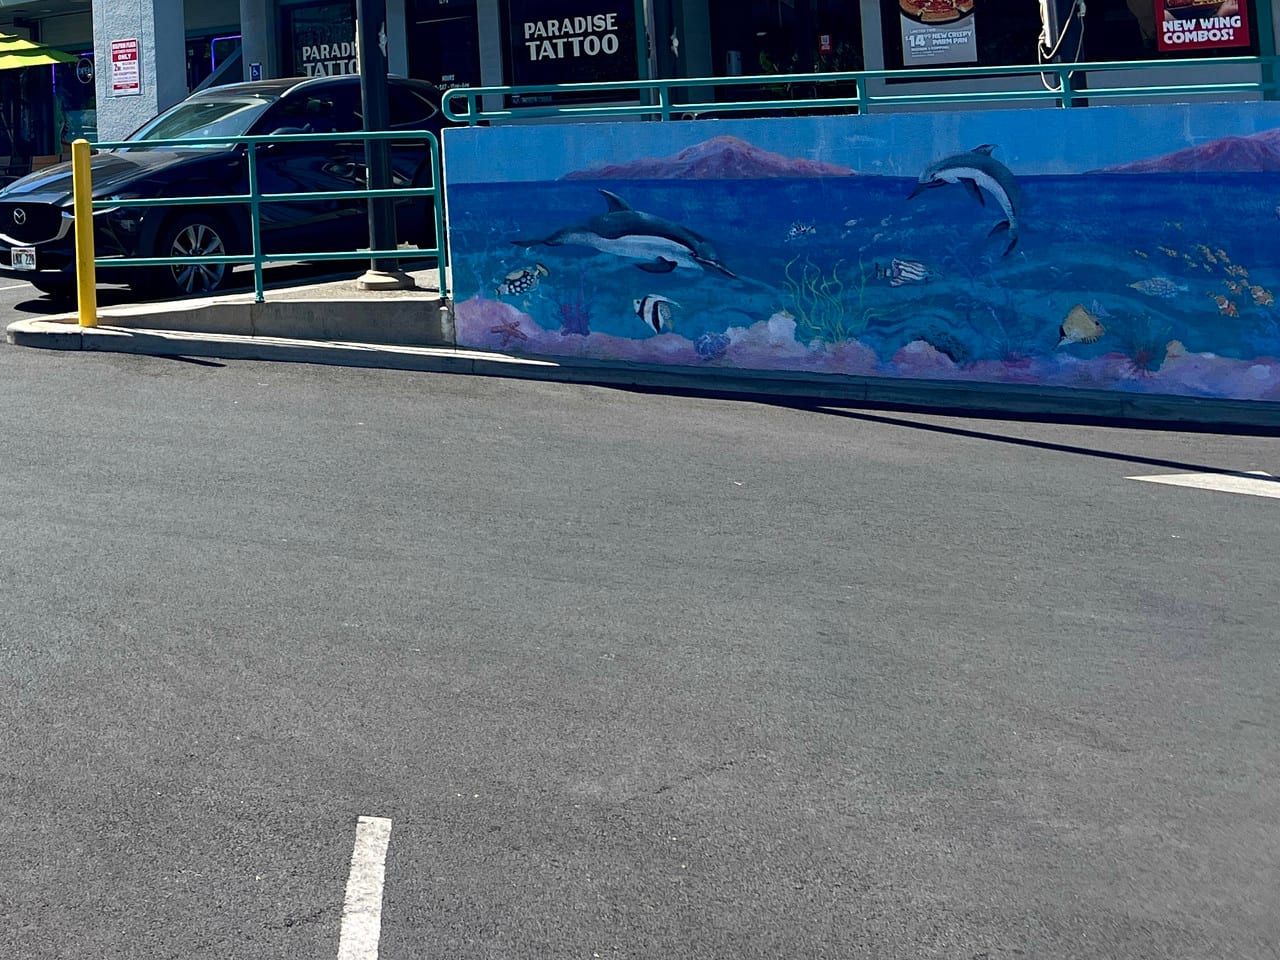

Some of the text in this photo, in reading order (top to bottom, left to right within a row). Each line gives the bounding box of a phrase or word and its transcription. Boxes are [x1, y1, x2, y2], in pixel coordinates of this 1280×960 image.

[524, 13, 618, 39] PARADISE
[1162, 15, 1241, 32] NEW WING
[948, 30, 972, 38] CRISPY
[1163, 28, 1234, 45] COMBOS!
[302, 41, 356, 60] PARADI
[525, 34, 619, 60] TATTOO
[303, 59, 357, 77] TATTO
